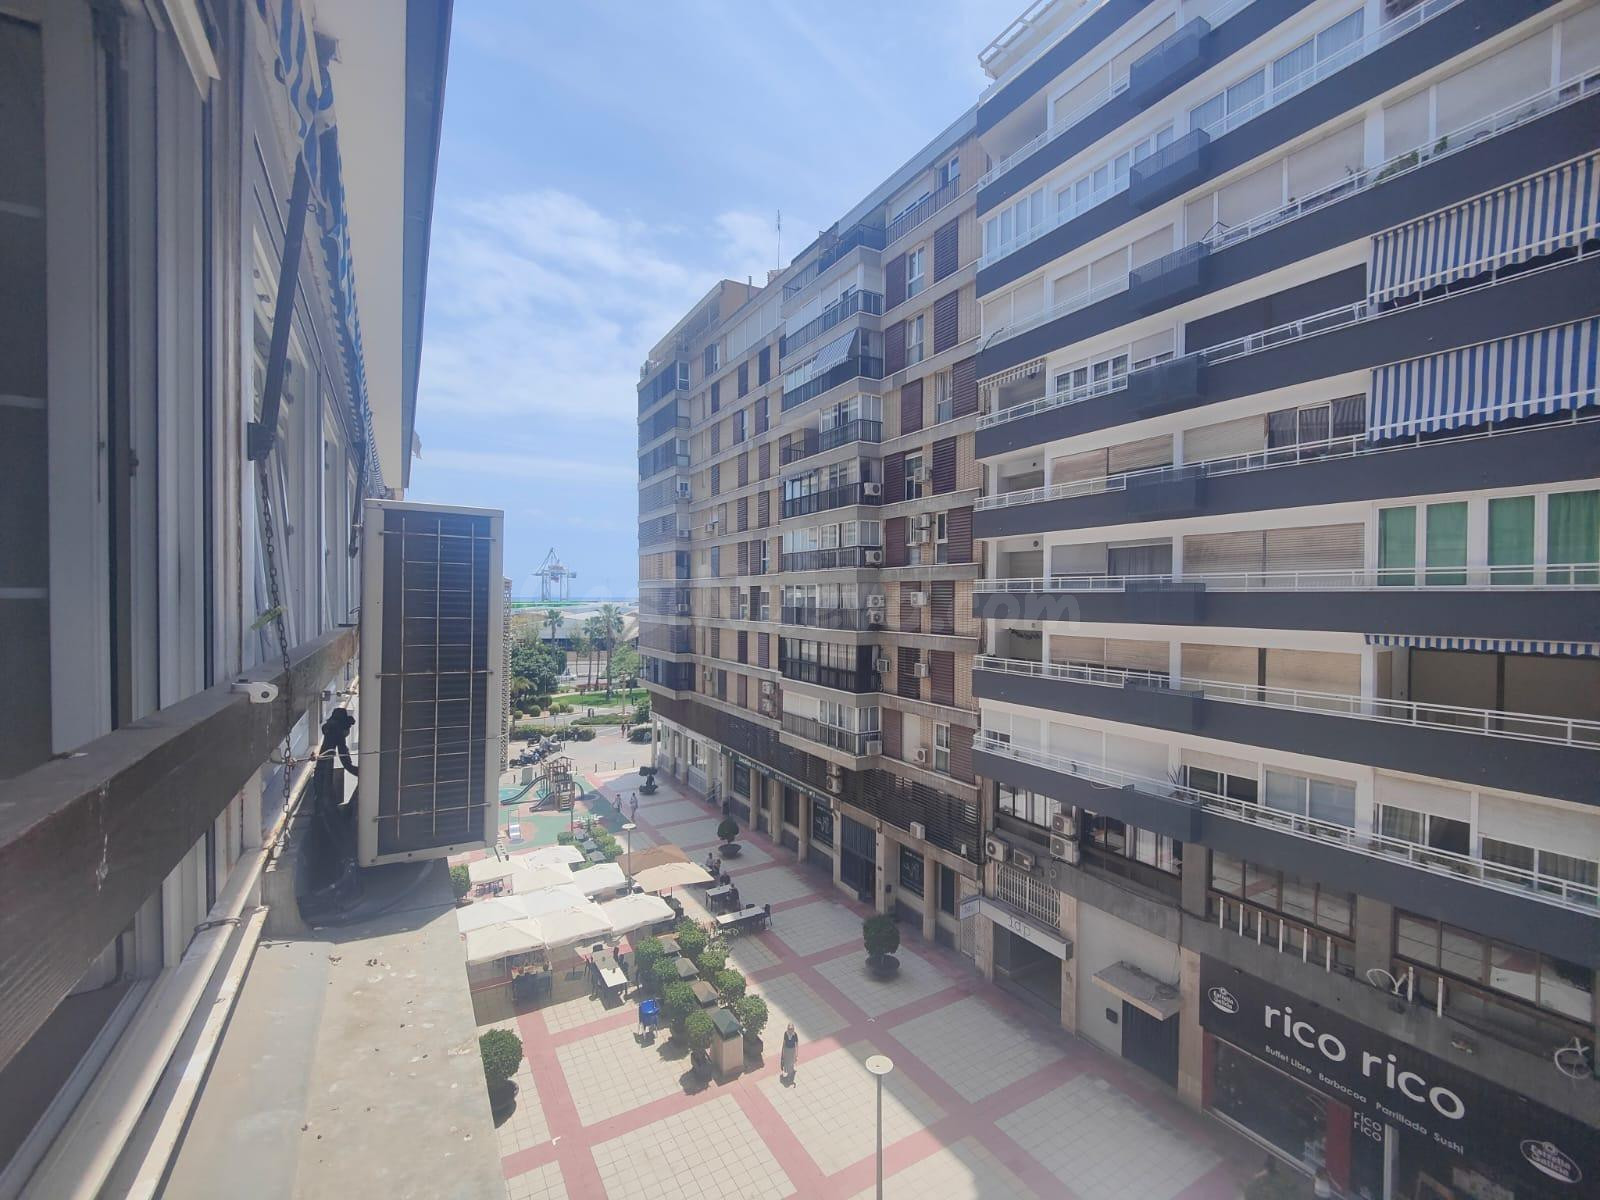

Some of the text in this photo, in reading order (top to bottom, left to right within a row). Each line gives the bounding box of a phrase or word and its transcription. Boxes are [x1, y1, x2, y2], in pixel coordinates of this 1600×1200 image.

[1265, 1005, 1465, 1119] rico rico
[1265, 1045, 1464, 1156] Buffet Libre Barbacoa Parrillada Sushi
[1353, 1111, 1382, 1132] rico
[1353, 1120, 1382, 1142] rico
